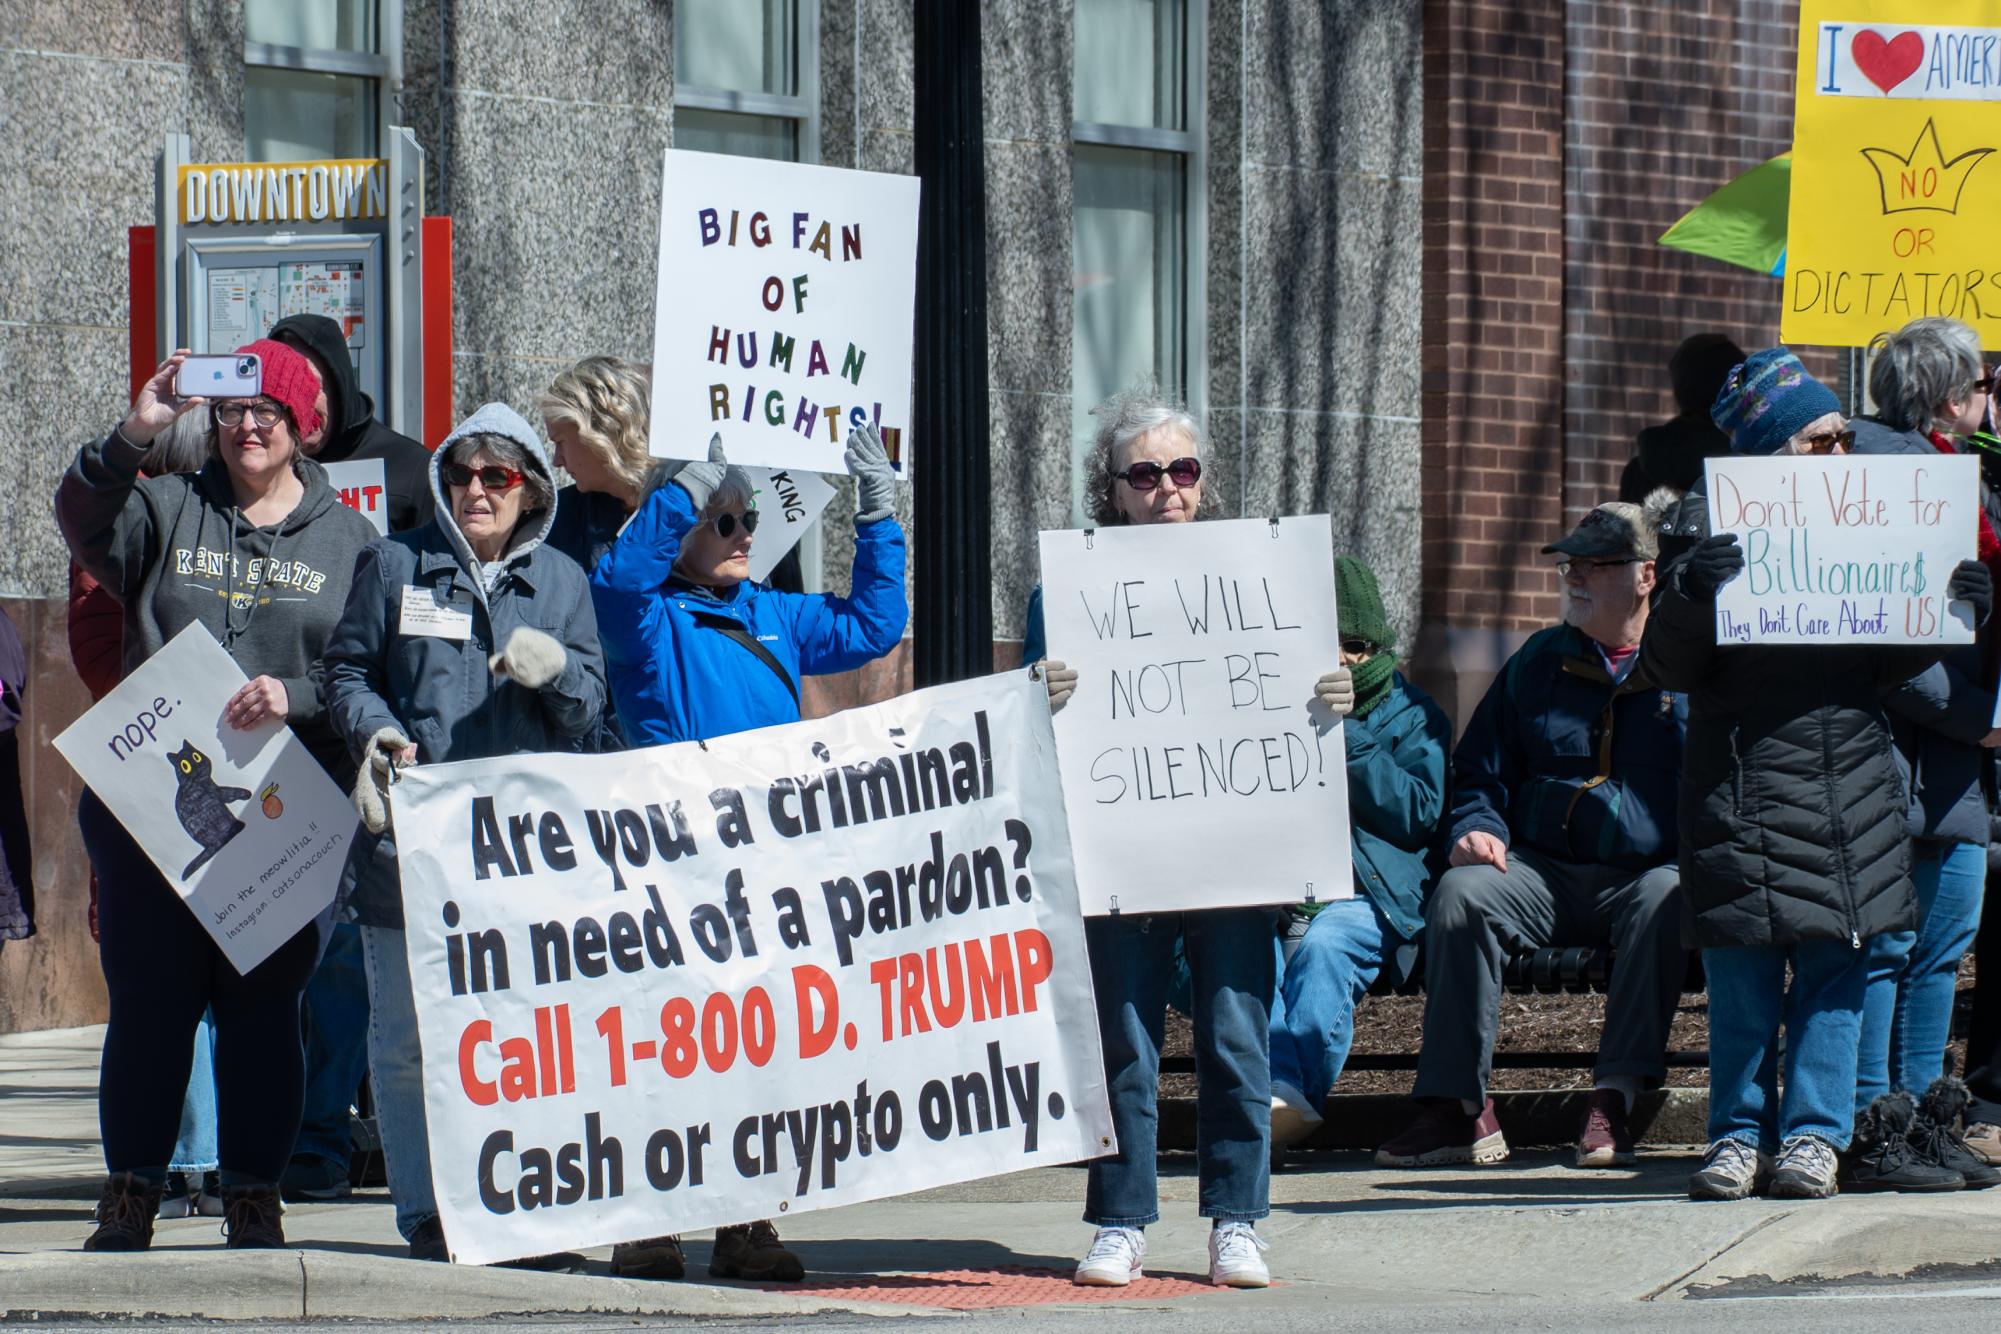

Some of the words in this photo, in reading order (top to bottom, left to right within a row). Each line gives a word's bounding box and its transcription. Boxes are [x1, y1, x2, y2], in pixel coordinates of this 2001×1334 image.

[1821, 26, 1843, 92] I
[186, 164, 387, 223] DOWNTOWN
[1901, 167, 1937, 199] NO
[698, 207, 772, 248] BIG
[792, 212, 862, 262] FAN
[1893, 228, 1935, 257] OR
[762, 273, 809, 315] OF
[707, 324, 867, 387] HUMAN
[1715, 471, 1807, 529] Don't
[1822, 467, 1889, 527] Vote
[1908, 467, 1951, 526] for
[176, 546, 240, 578] KENT
[247, 557, 327, 594] STATE
[1747, 527, 1927, 598] Billionaire$
[1080, 579, 1153, 641] WE
[1174, 573, 1302, 635] WILL
[1718, 608, 1751, 643] They
[1759, 604, 1791, 637] Don't
[1796, 602, 1831, 636] Care
[1837, 597, 1889, 637] About
[1905, 596, 1946, 639] US!
[1111, 659, 1207, 720] NOT
[1224, 652, 1291, 710] BE
[108, 696, 182, 761] nope.
[1090, 718, 1327, 804] SILENCED!
[472, 796, 577, 881] Are
[584, 799, 698, 892] you
[713, 787, 755, 849] a
[768, 711, 994, 839] criminal
[215, 903, 238, 925] Join
[237, 885, 257, 902] the
[442, 900, 511, 996] in
[529, 884, 685, 987] need
[688, 867, 758, 964] of
[771, 888, 811, 950] a
[820, 819, 1033, 967] pardon?
[458, 1003, 576, 1106] Call
[595, 986, 776, 1087] 1-800
[791, 964, 859, 1060] D.
[869, 928, 1054, 1042] TRUMP
[478, 1111, 624, 1216] Cash
[645, 1122, 712, 1192] or
[732, 1078, 903, 1198] crypto
[918, 1040, 1066, 1154] only.
